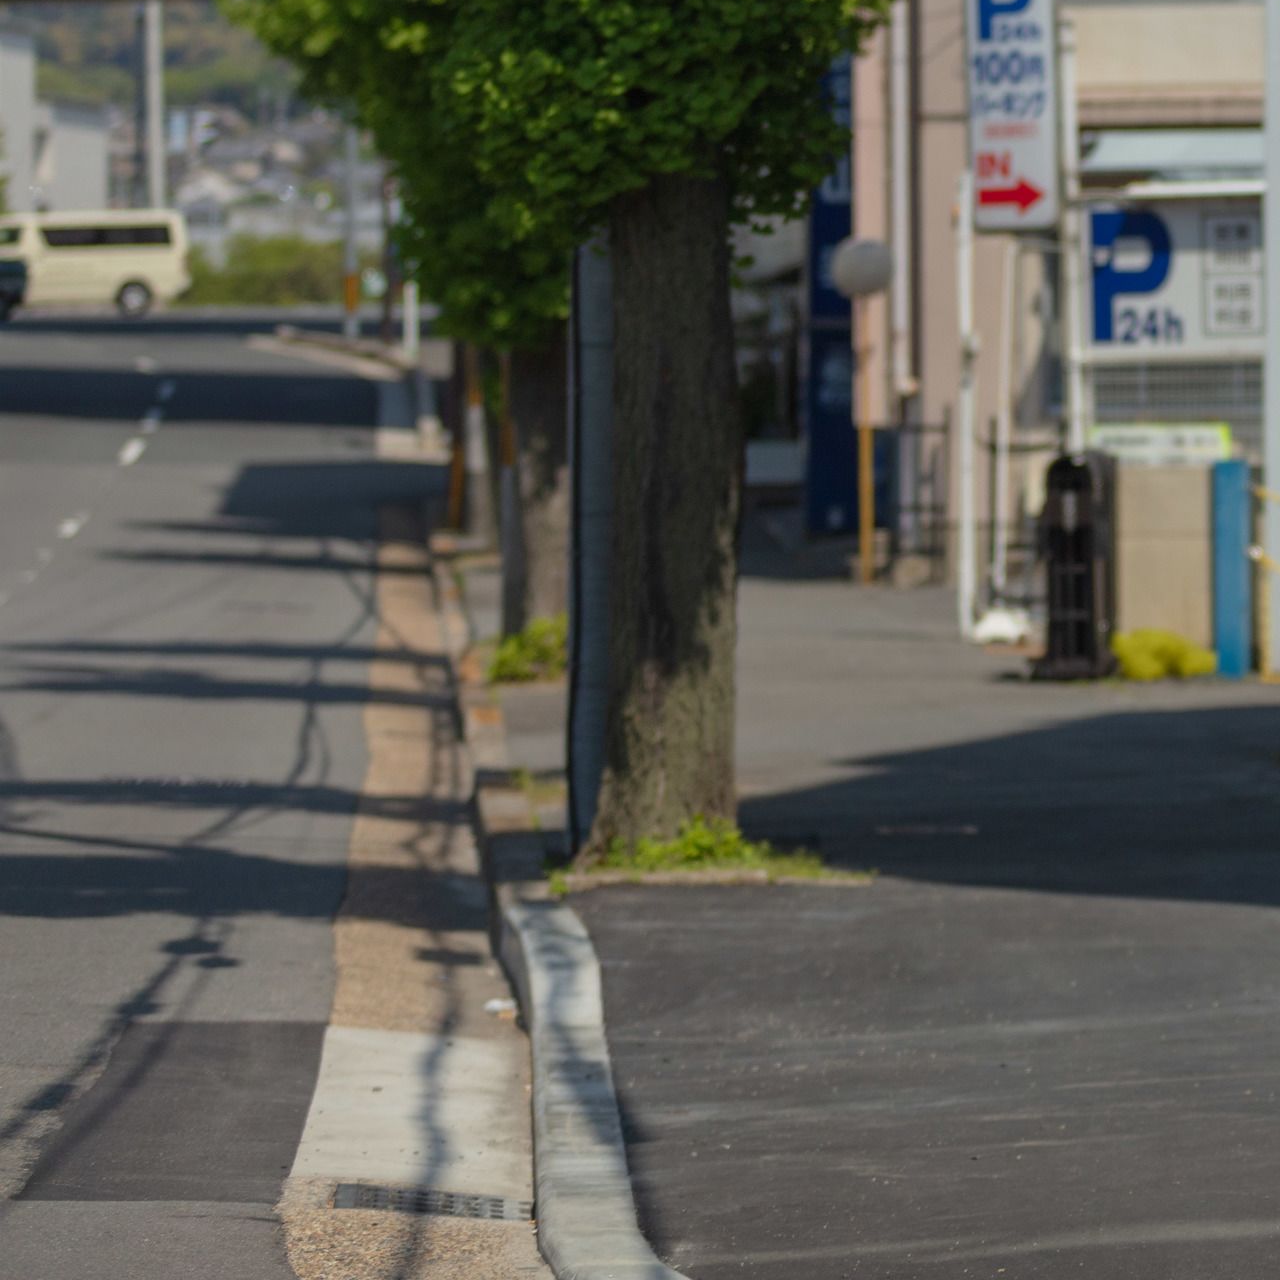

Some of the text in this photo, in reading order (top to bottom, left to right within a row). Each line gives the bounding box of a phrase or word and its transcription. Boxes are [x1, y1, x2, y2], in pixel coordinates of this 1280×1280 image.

[973, 51, 1044, 85] 100円
[976, 152, 1011, 178] IN
[1092, 208, 1171, 341] P
[1120, 307, 1184, 343] 24h
